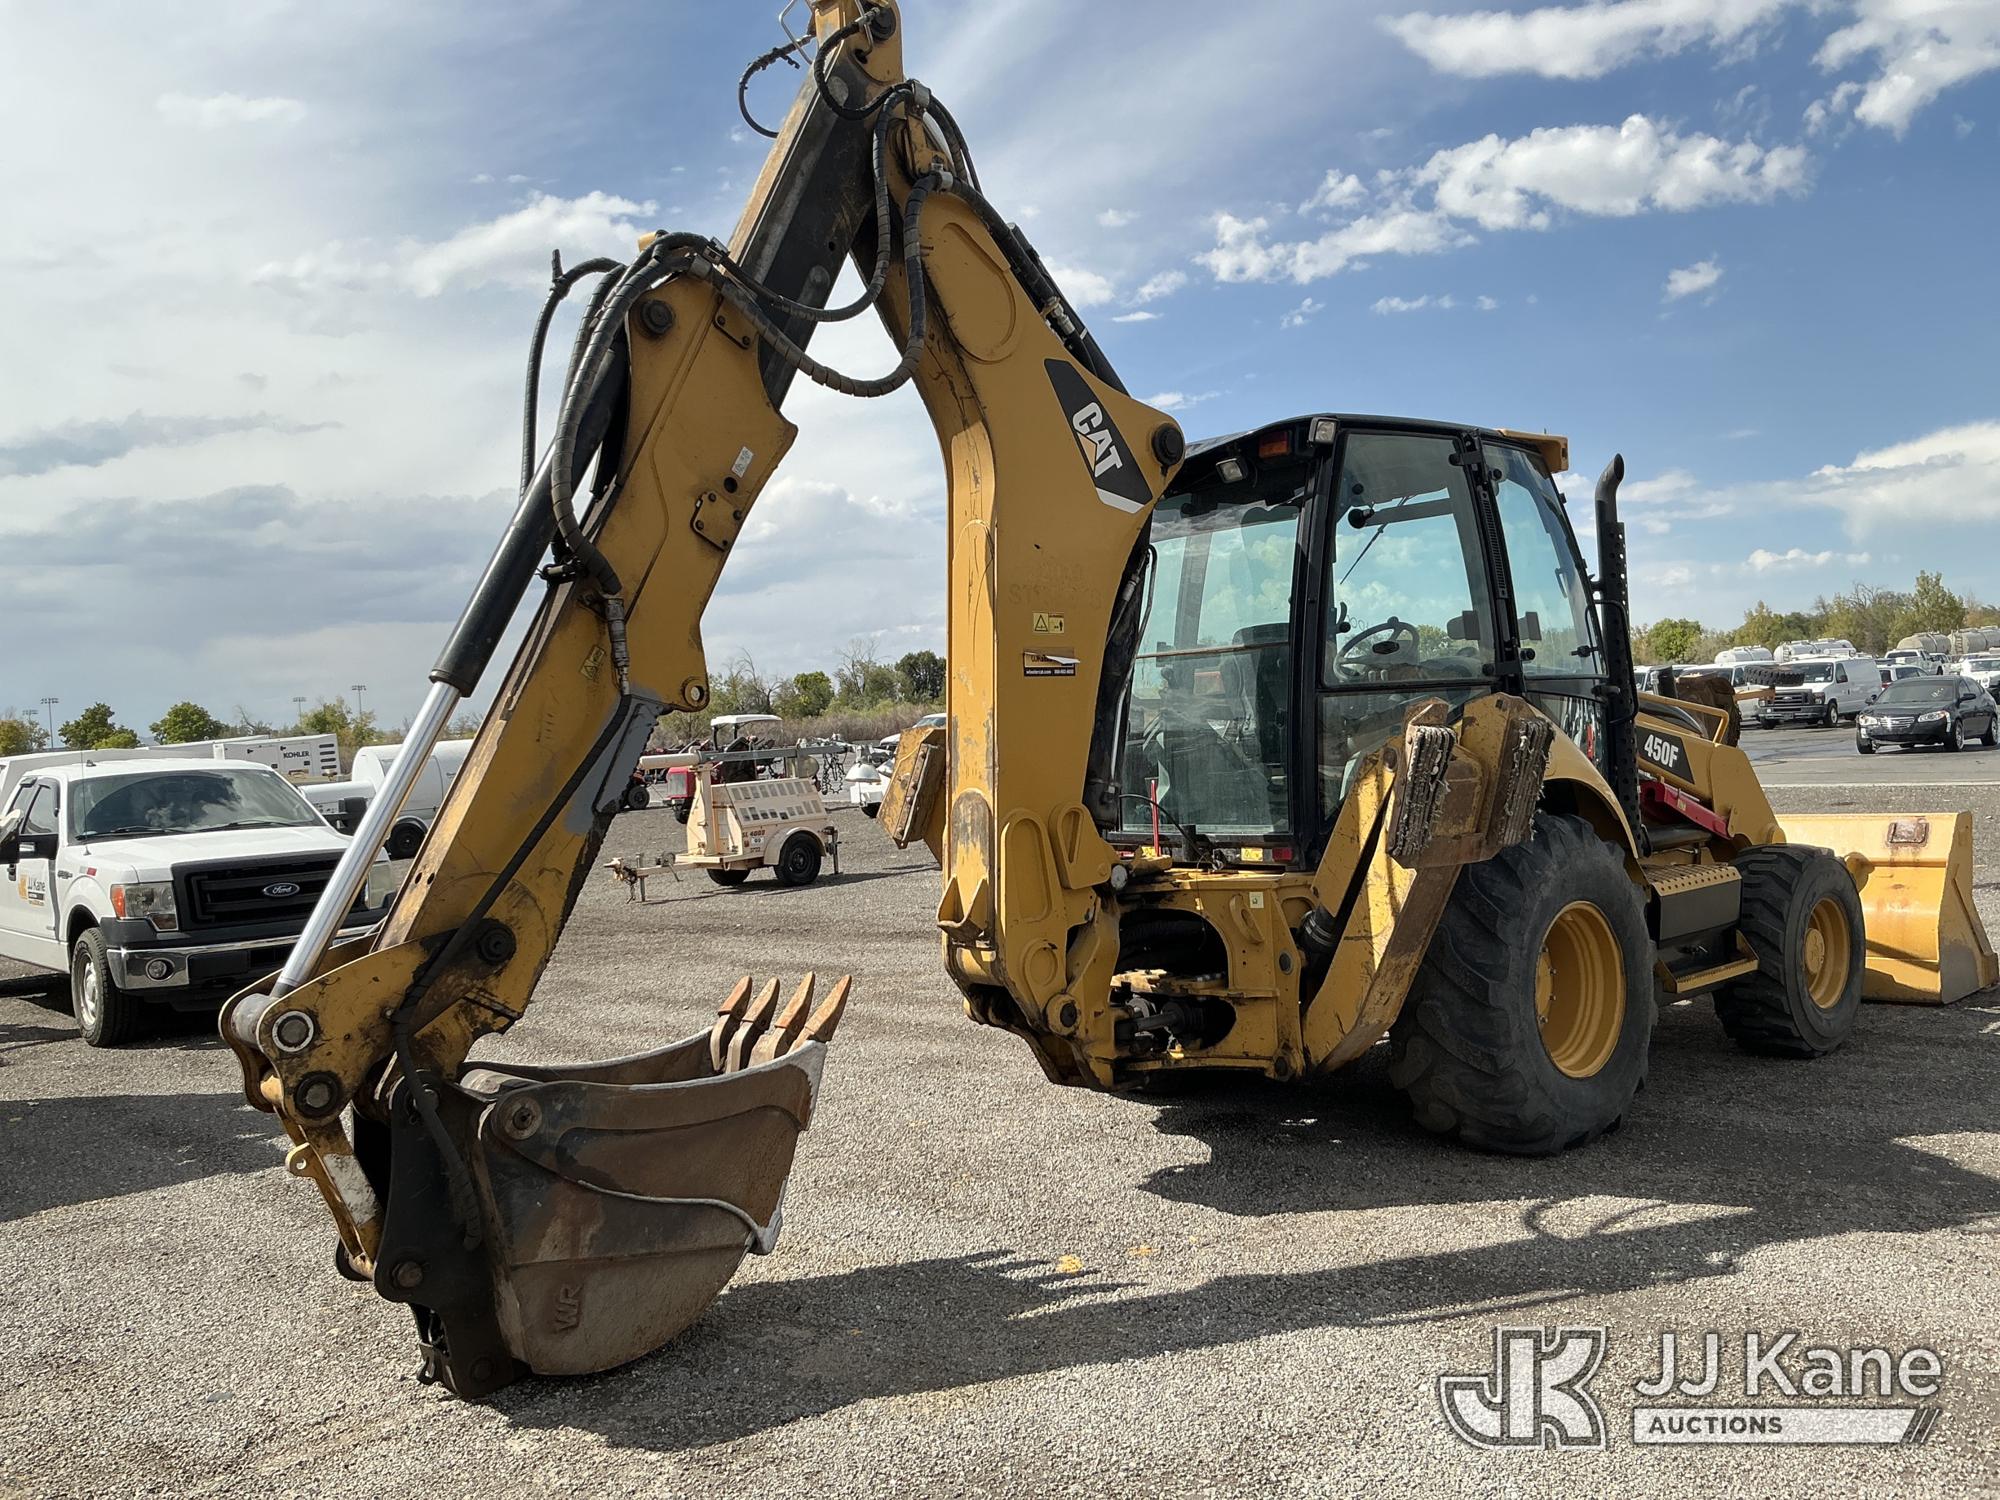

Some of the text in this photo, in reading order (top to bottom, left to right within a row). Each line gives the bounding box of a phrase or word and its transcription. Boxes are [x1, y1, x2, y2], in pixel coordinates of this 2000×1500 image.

[1073, 402, 1123, 477] CAT
[283, 750, 310, 758] KOHLER
[1644, 734, 1679, 768] 450F
[272, 885, 293, 894] Ford
